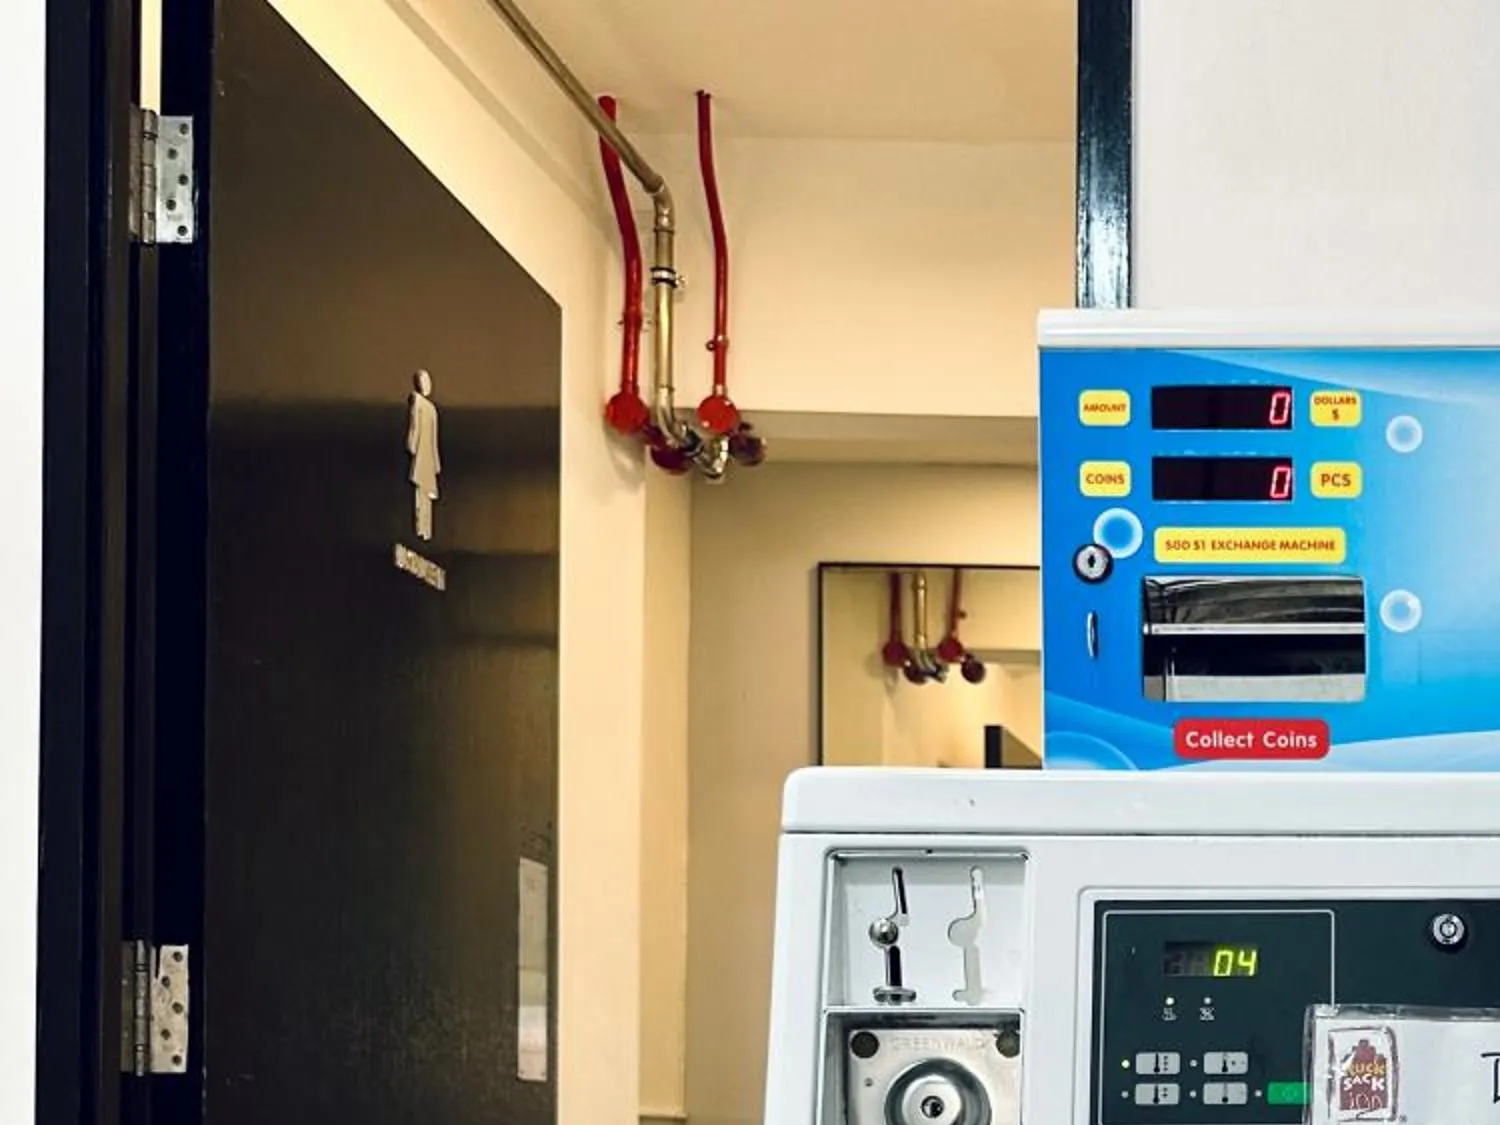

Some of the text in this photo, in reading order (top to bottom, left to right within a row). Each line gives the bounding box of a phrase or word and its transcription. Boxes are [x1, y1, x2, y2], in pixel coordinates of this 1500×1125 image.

[1083, 402, 1127, 413] AMOUNT
[1268, 391, 1291, 425] 0
[1313, 396, 1358, 406] DOLLARS
[1085, 473, 1126, 485] COINS
[1269, 465, 1292, 498] 0
[1320, 473, 1352, 488] PCS
[1210, 540, 1277, 551] EXCHANGE
[1279, 540, 1336, 551] MACHINE
[1184, 729, 1318, 748] Collect Coins
[1212, 950, 1257, 978] 04
